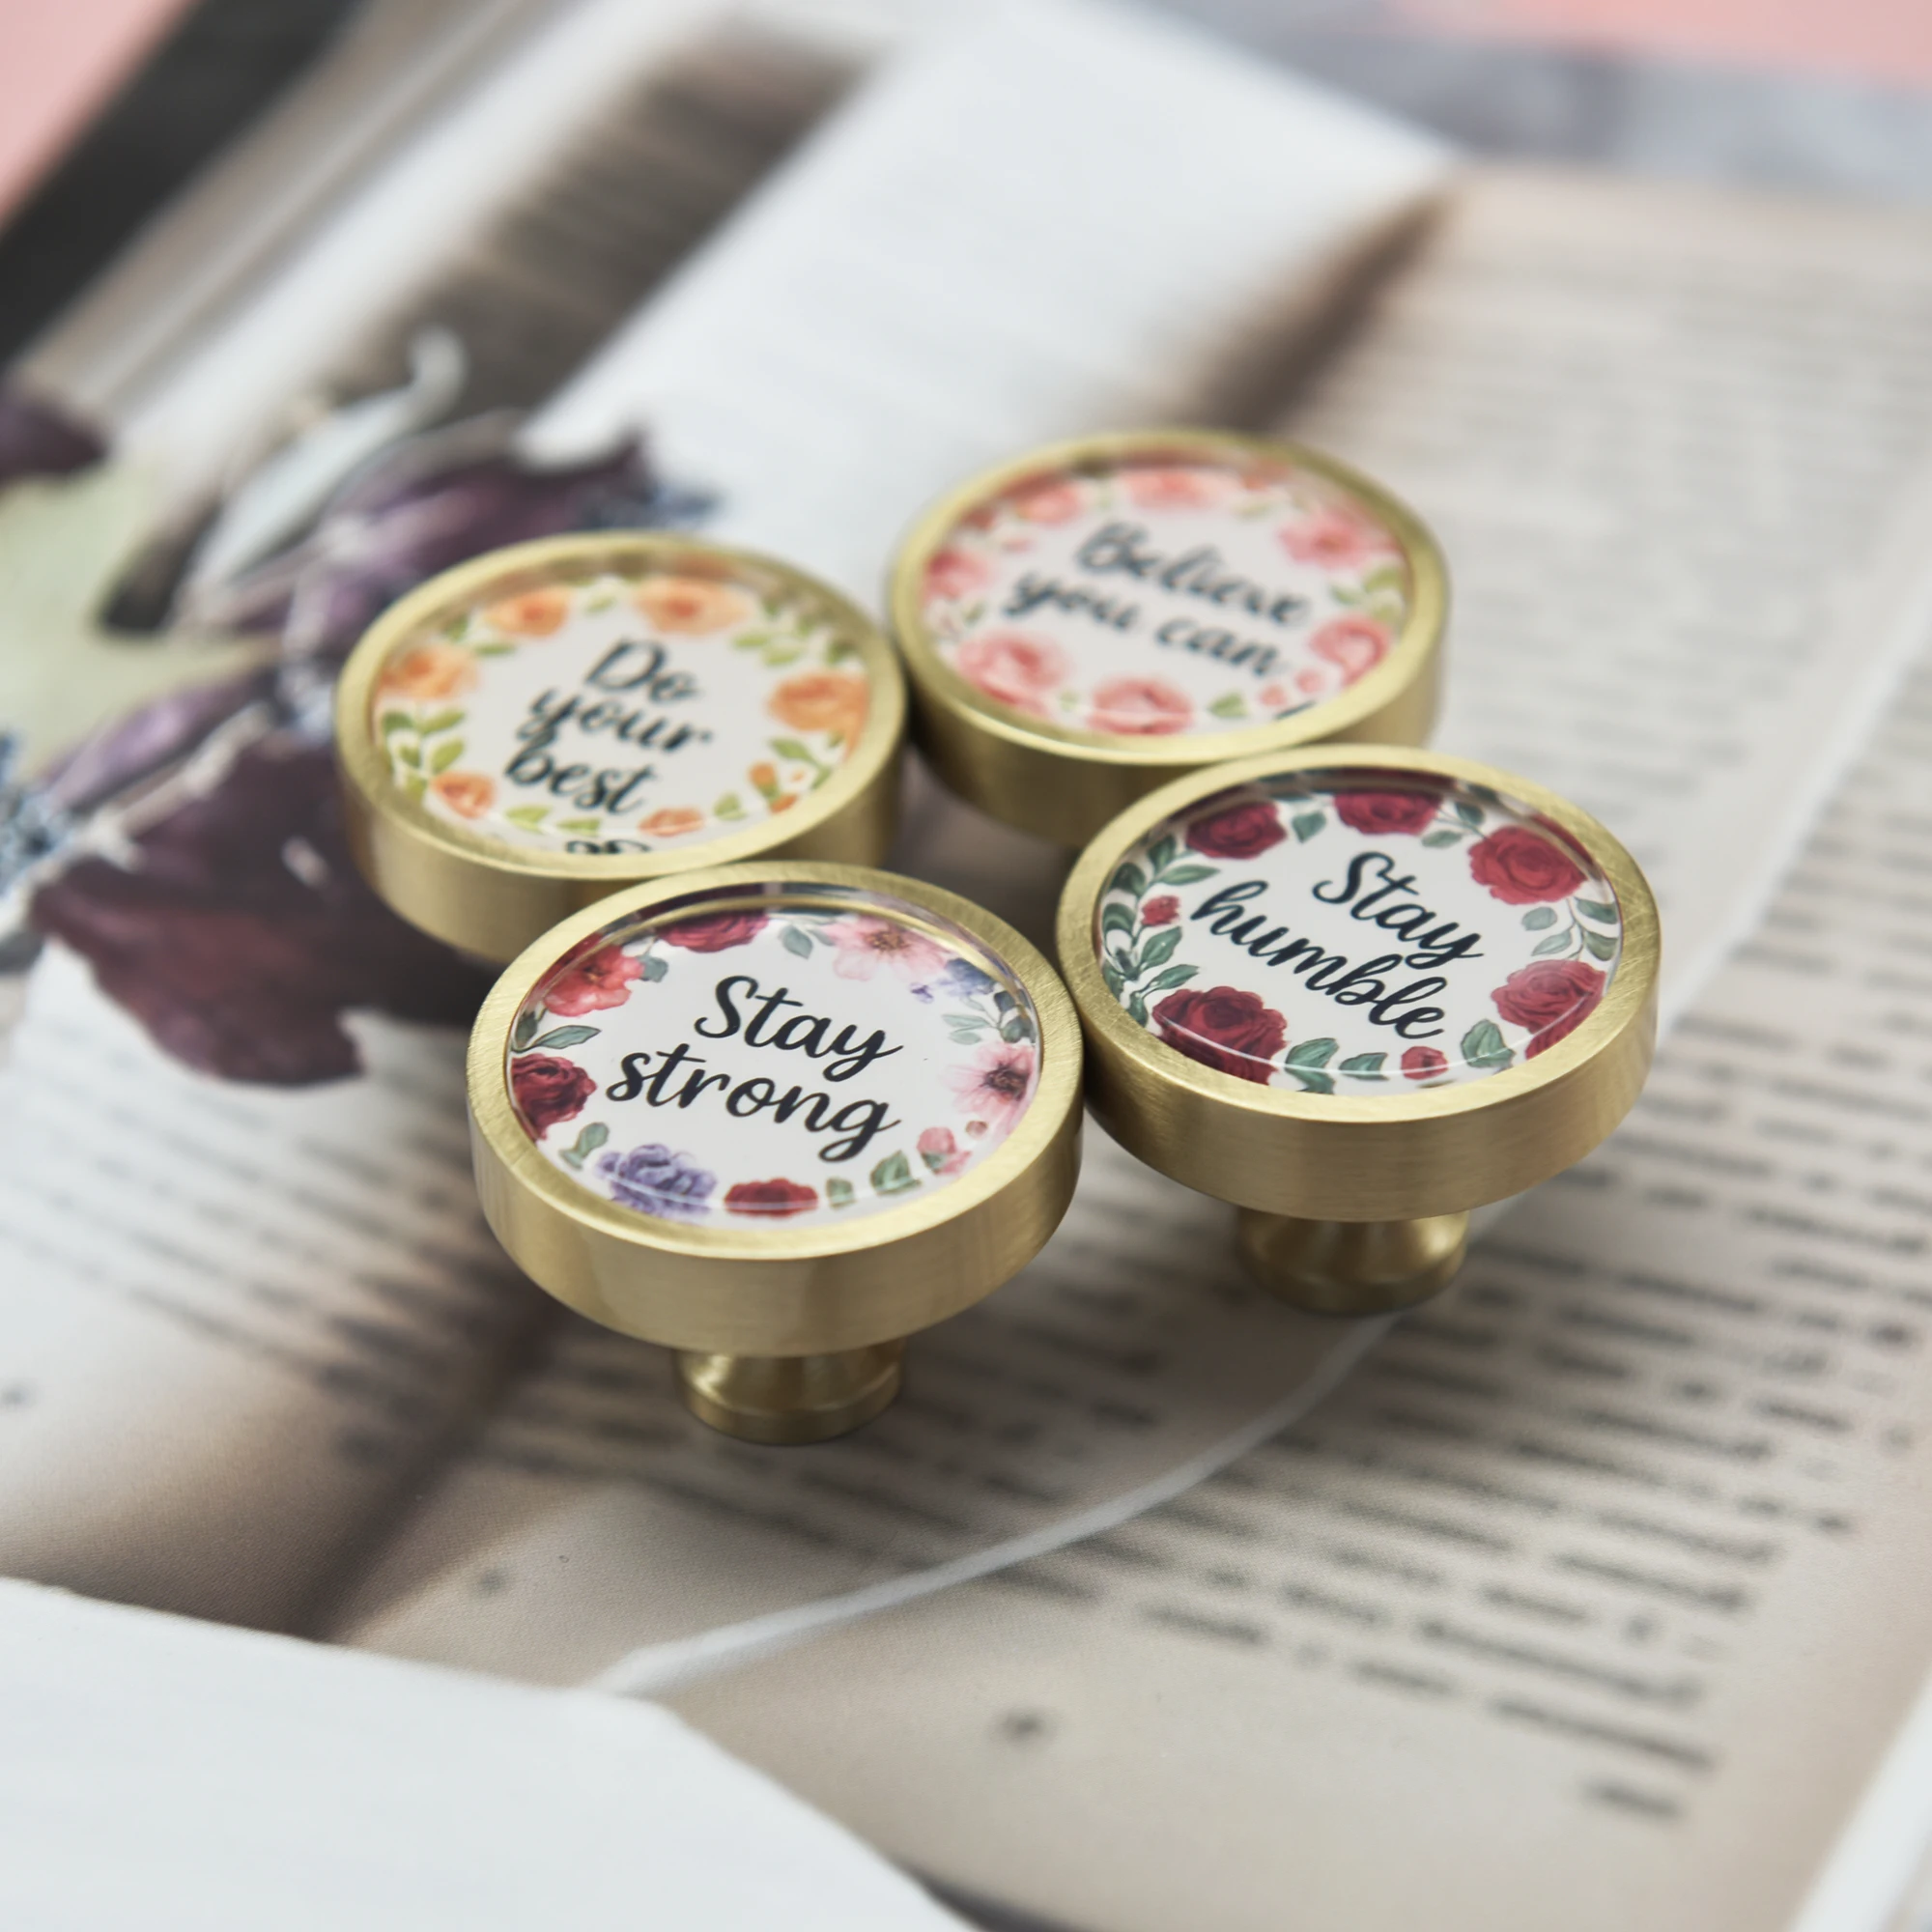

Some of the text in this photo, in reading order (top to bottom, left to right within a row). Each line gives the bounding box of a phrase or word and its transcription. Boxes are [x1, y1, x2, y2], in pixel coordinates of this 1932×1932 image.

[1002, 572, 1281, 676] you can
[1076, 522, 1308, 624] Believe
[516, 688, 713, 753] your
[582, 639, 699, 702] Do
[504, 733, 657, 814] best
[1190, 880, 1448, 1040] humble
[1312, 851, 1485, 968] Stay
[695, 975, 903, 1083] Stay
[605, 1042, 901, 1162] strong
